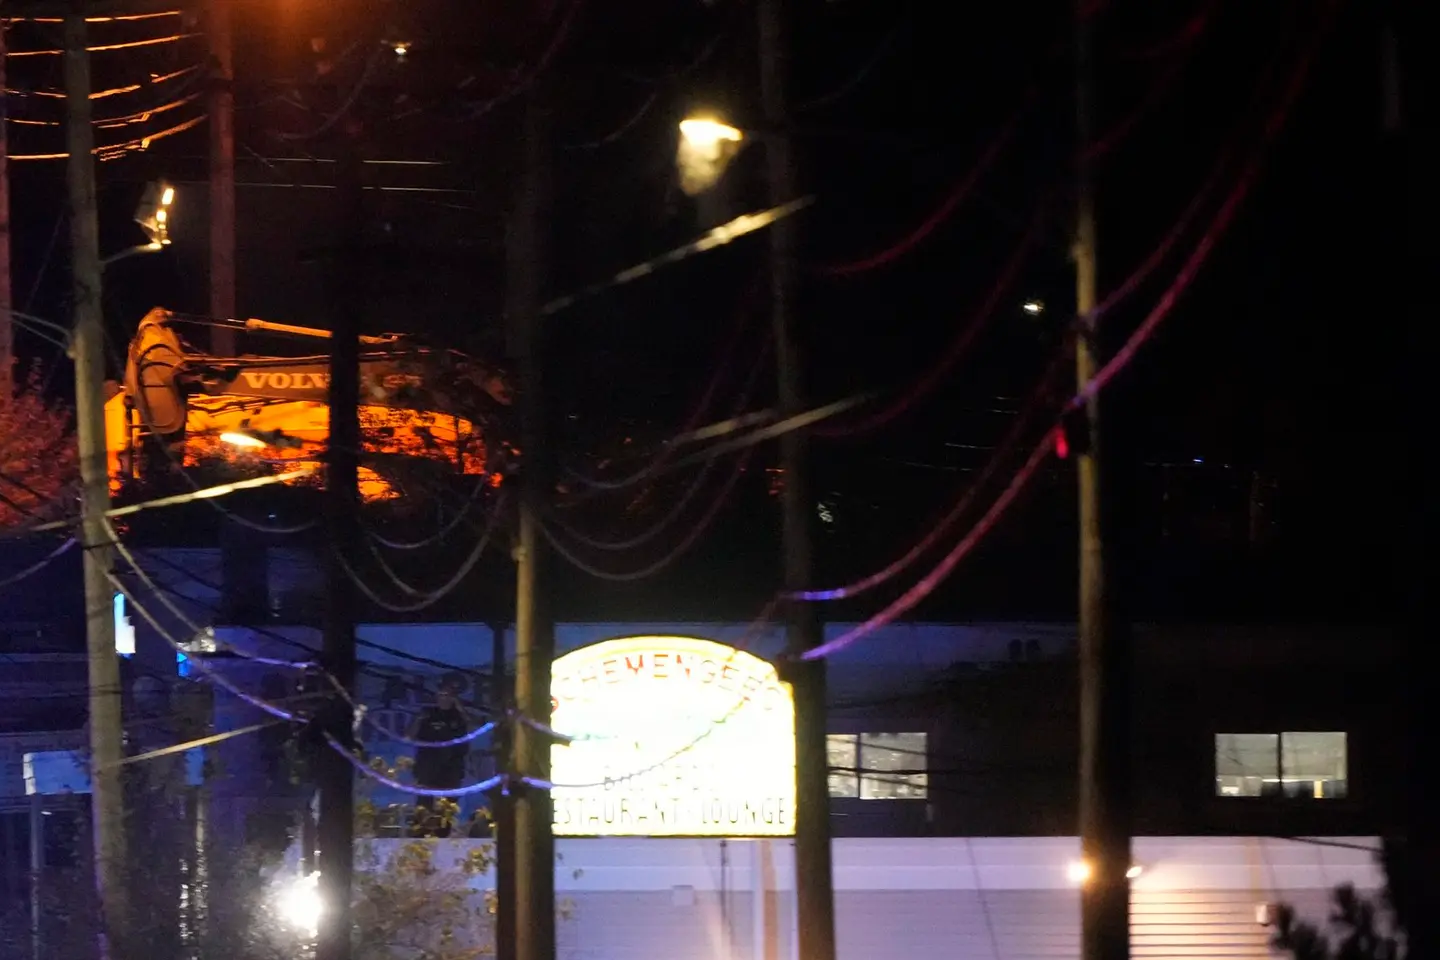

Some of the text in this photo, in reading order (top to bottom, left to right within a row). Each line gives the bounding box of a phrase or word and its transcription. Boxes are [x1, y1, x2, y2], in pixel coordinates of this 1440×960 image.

[241, 372, 329, 389] VOLV
[552, 798, 785, 824] ESTAURANT LOUNGE
